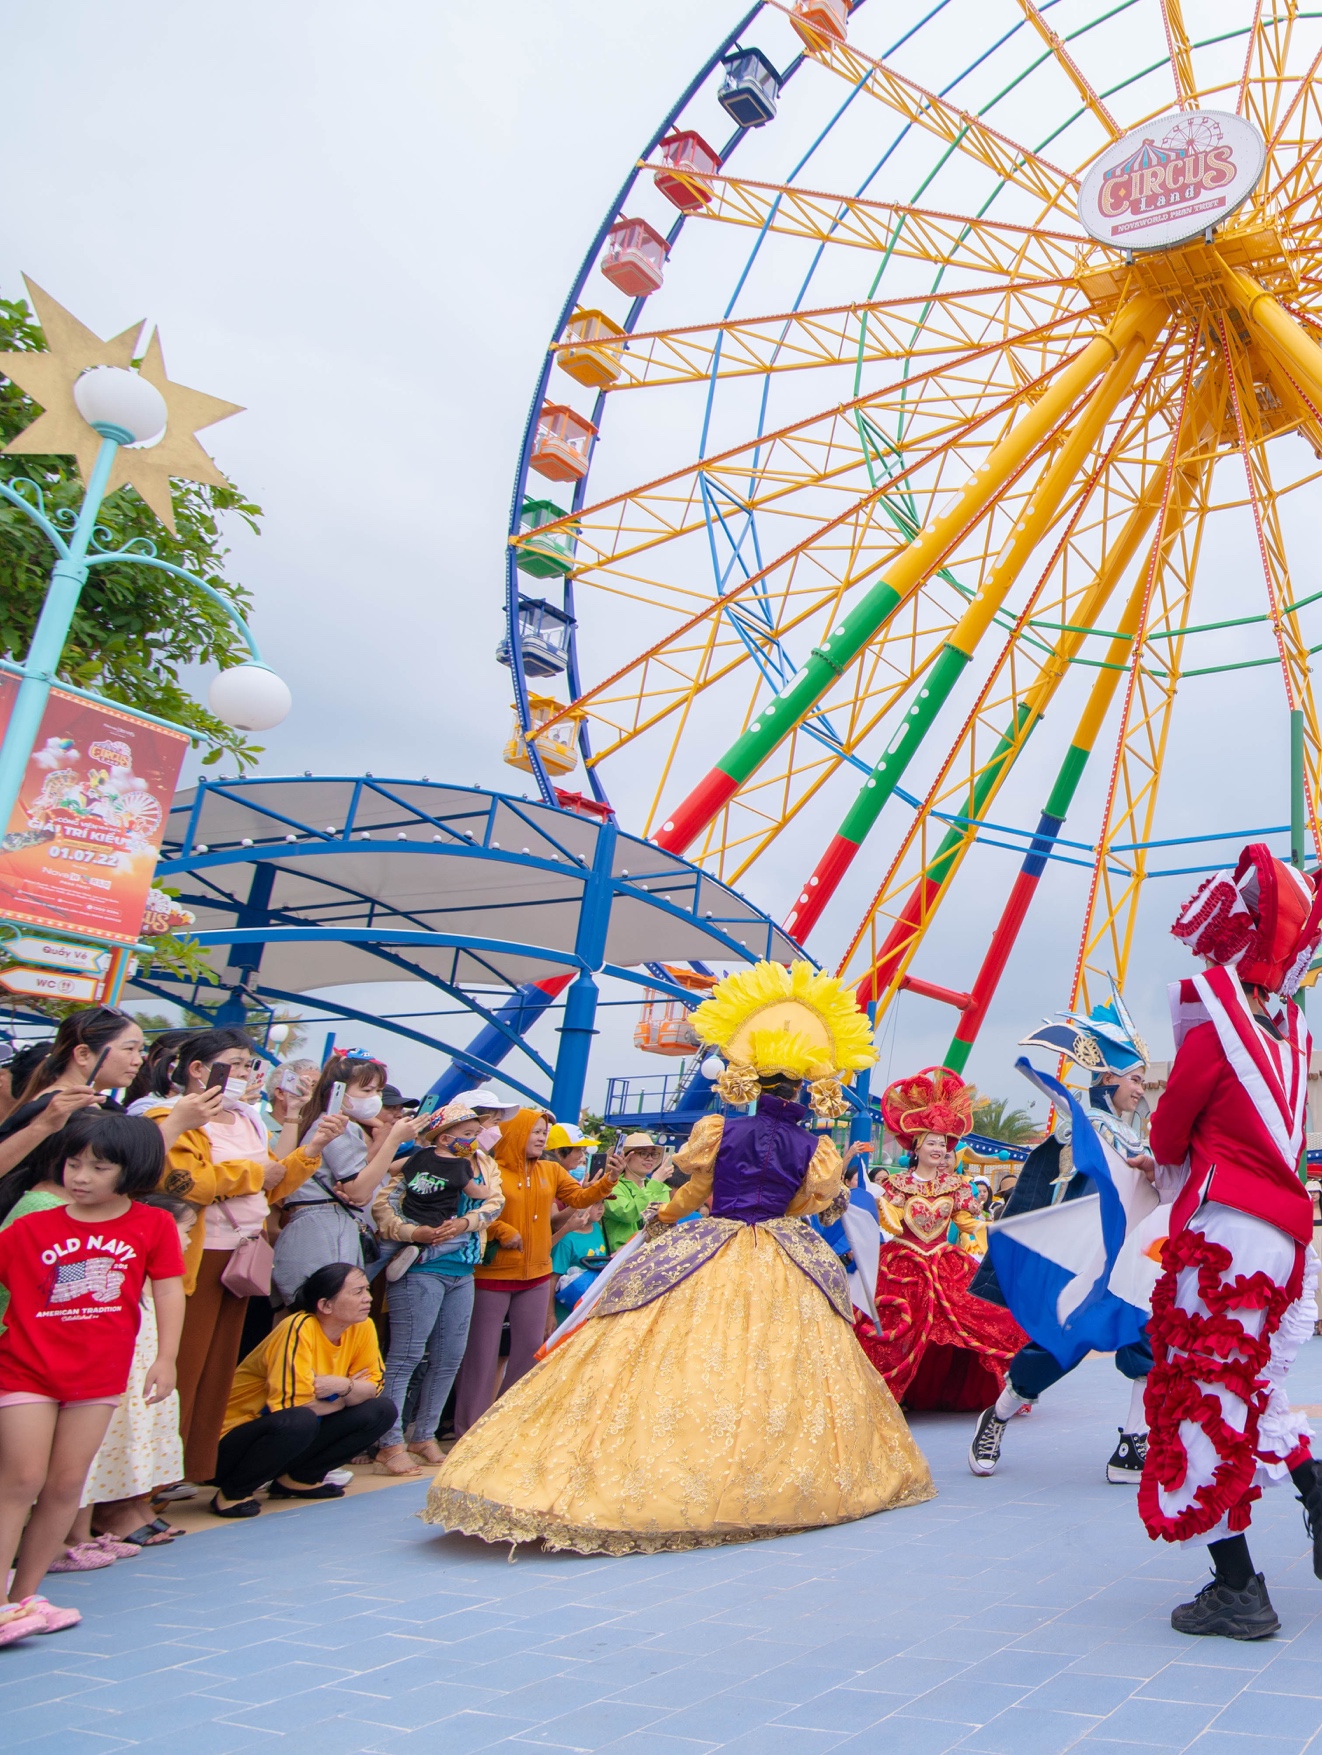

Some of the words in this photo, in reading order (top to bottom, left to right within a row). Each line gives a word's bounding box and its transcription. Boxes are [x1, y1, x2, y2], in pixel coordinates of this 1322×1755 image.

[1101, 146, 1235, 216] CIRCUS
[1139, 185, 1195, 212] Land
[91, 745, 129, 768] CIRCUS
[64, 825, 87, 839] TRÍ
[49, 846, 118, 867] 01.07.22
[36, 979, 57, 989] WC
[41, 1237, 81, 1265] OLD
[86, 1235, 137, 1262] NAVY
[36, 1308, 79, 1318] AMERICAN
[81, 1306, 122, 1315] TRADITION
